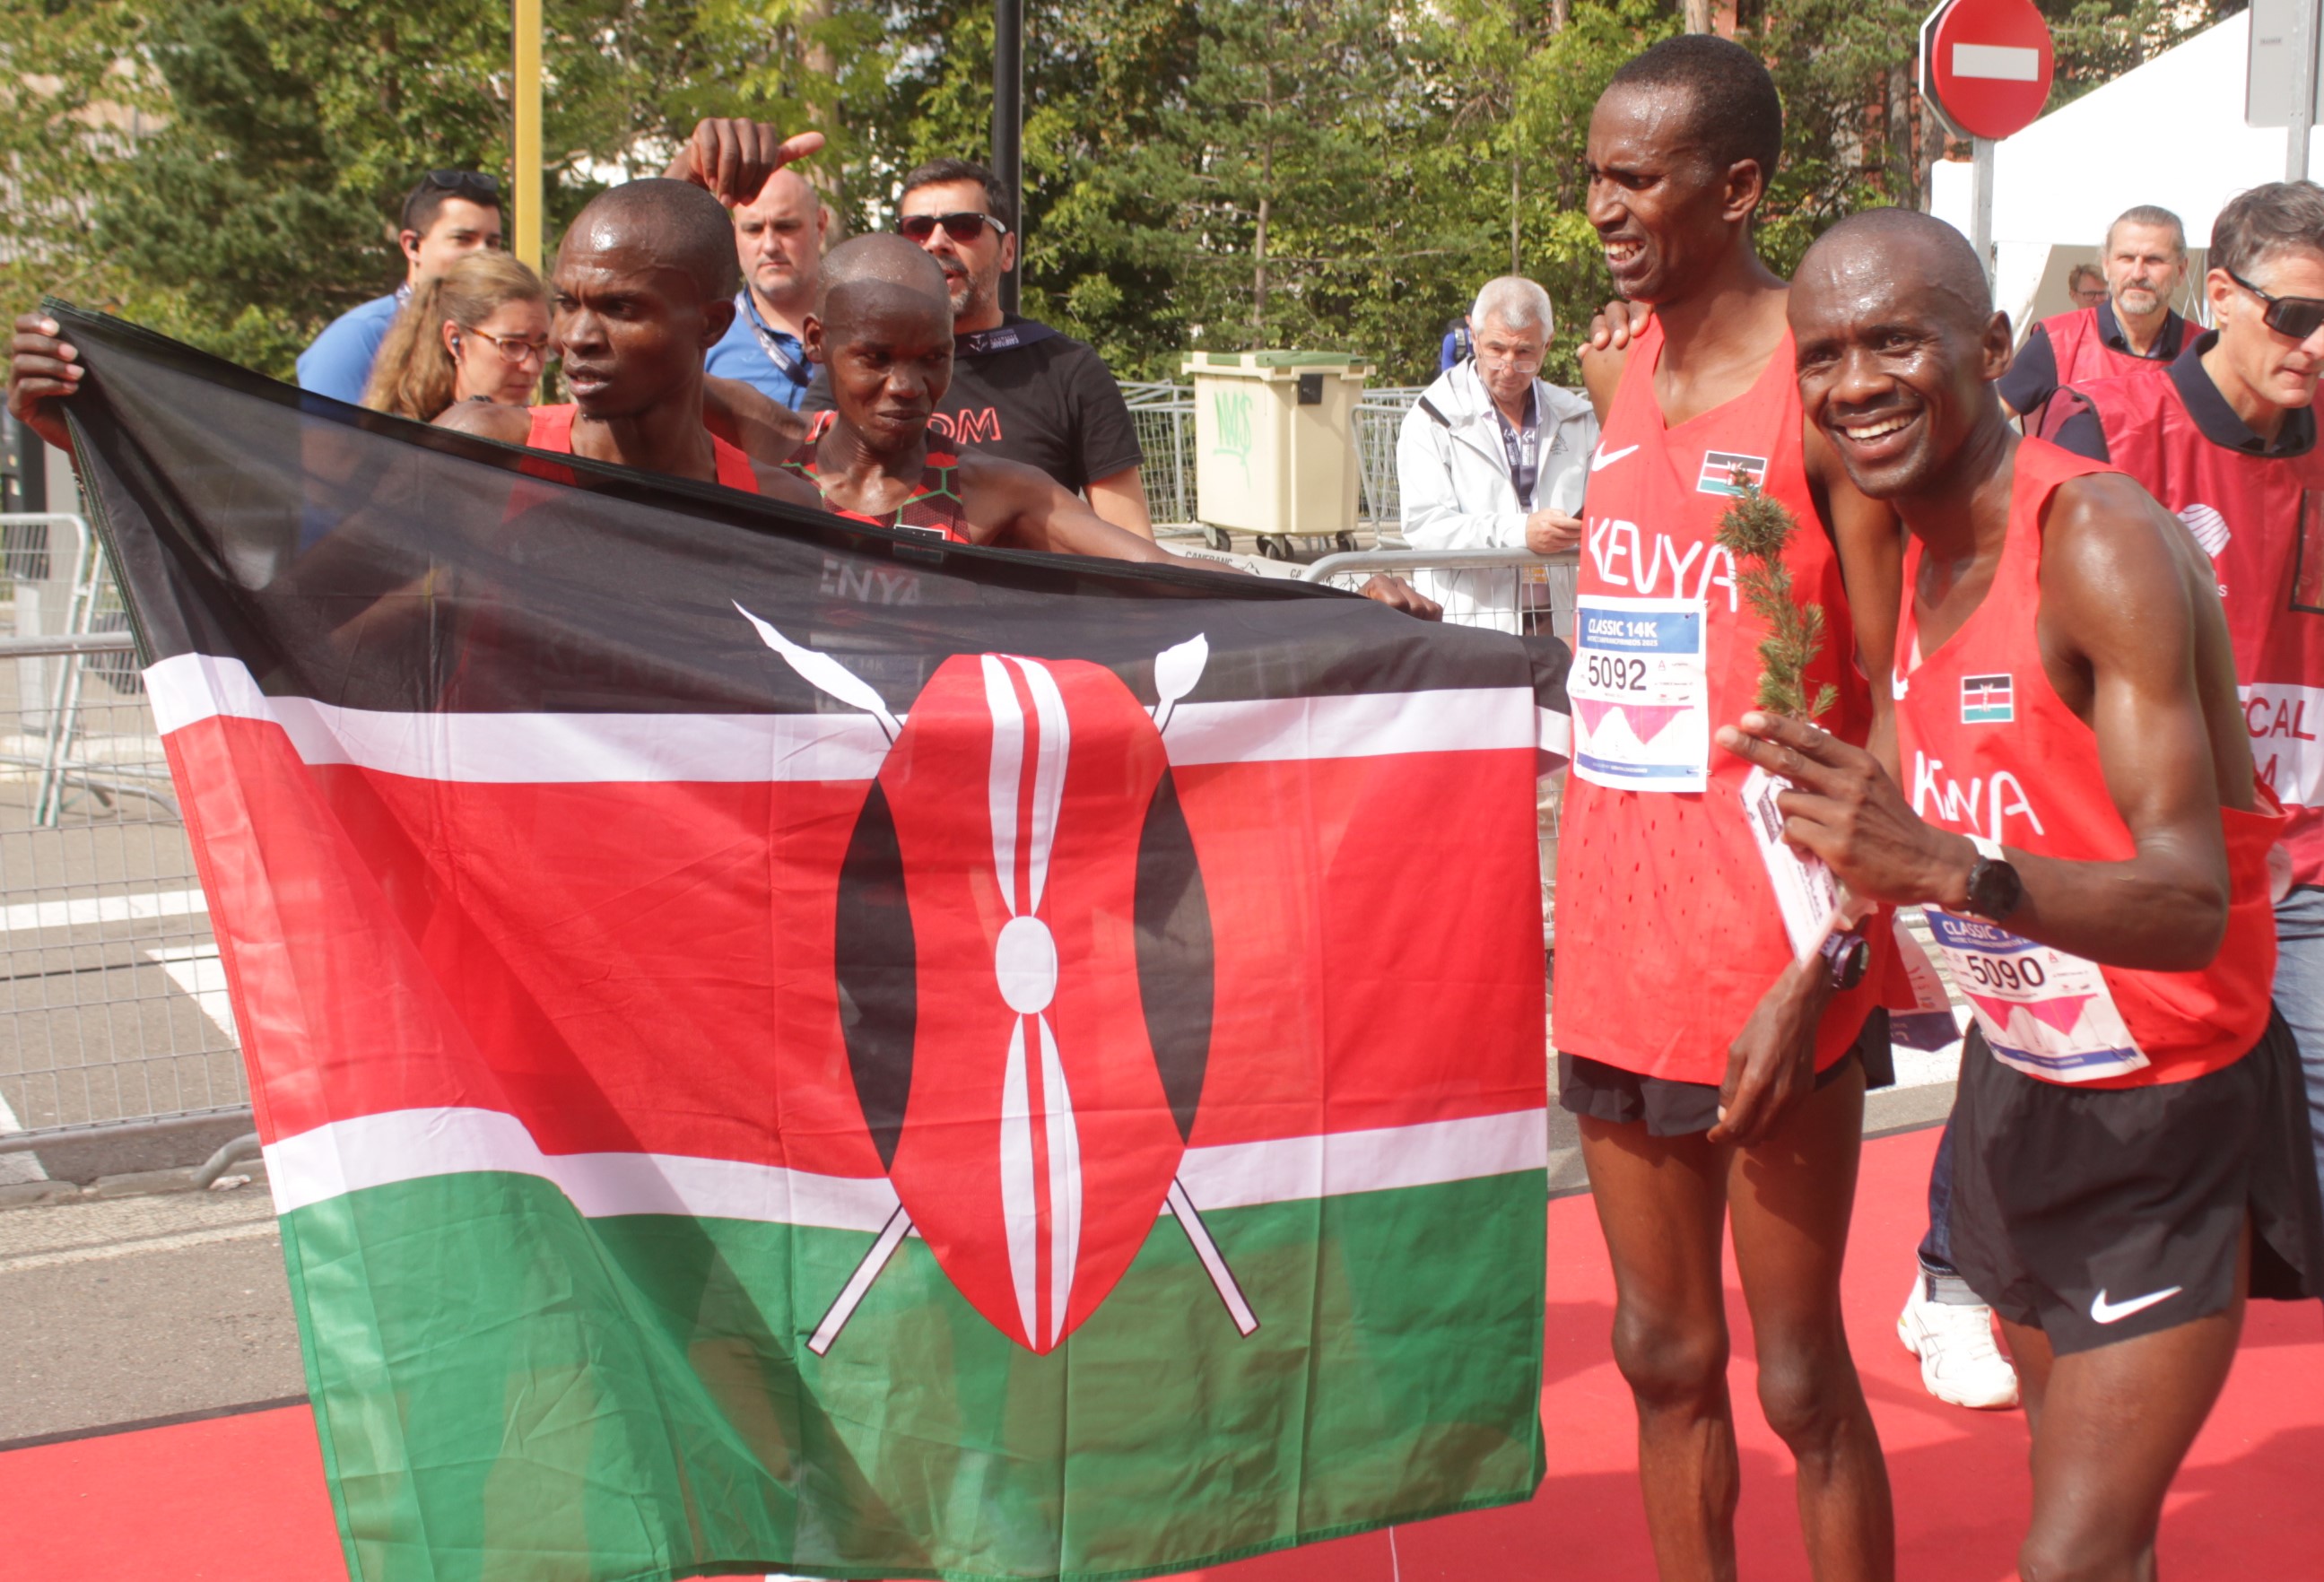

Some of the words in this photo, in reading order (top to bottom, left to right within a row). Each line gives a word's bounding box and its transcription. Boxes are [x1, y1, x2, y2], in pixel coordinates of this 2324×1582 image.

[820, 558, 921, 606] ENYA
[1588, 618, 1624, 637] CLASSIC
[1626, 621, 1658, 639] 14K
[1588, 655, 1647, 691] 5092
[2241, 697, 2316, 742] CAL
[1942, 920, 1998, 941] CLASSIC
[1966, 955, 2045, 990] 5090
